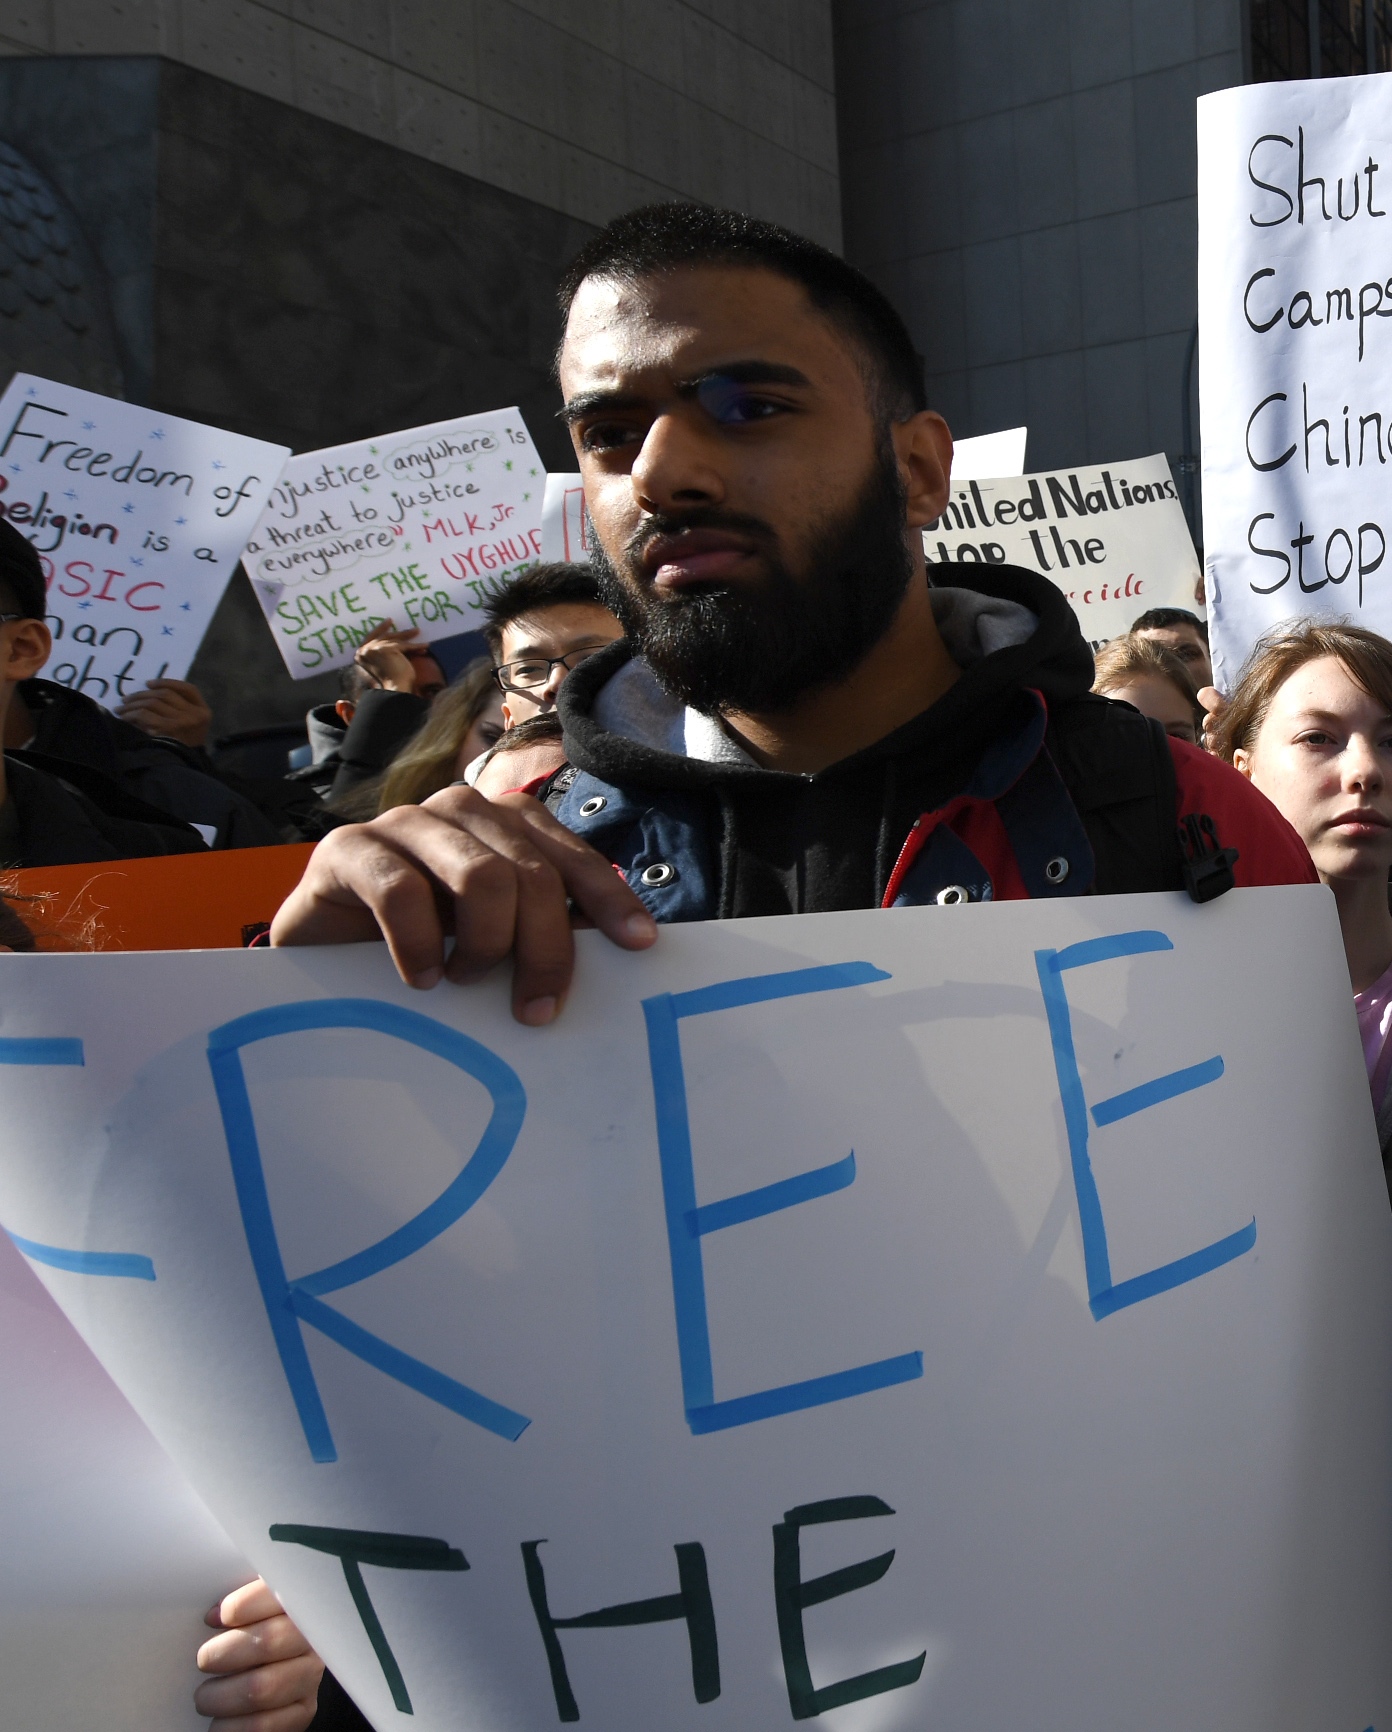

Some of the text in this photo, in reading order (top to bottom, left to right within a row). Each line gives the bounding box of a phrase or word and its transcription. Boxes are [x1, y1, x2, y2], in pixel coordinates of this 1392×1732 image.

[1248, 125, 1386, 228] Shut
[0, 401, 262, 518] Freedom of
[267, 464, 380, 519] njustice
[505, 428, 527, 444] is
[0, 491, 218, 563] eligion is a
[247, 480, 480, 554] a threat to justice
[922, 479, 1046, 531] nited
[926, 525, 1107, 572] top the
[1247, 512, 1386, 609] Stop
[276, 582, 367, 635] SAVE
[369, 563, 431, 600] THE
[403, 590, 464, 629] FOR
[268, 1491, 928, 1723] THE
